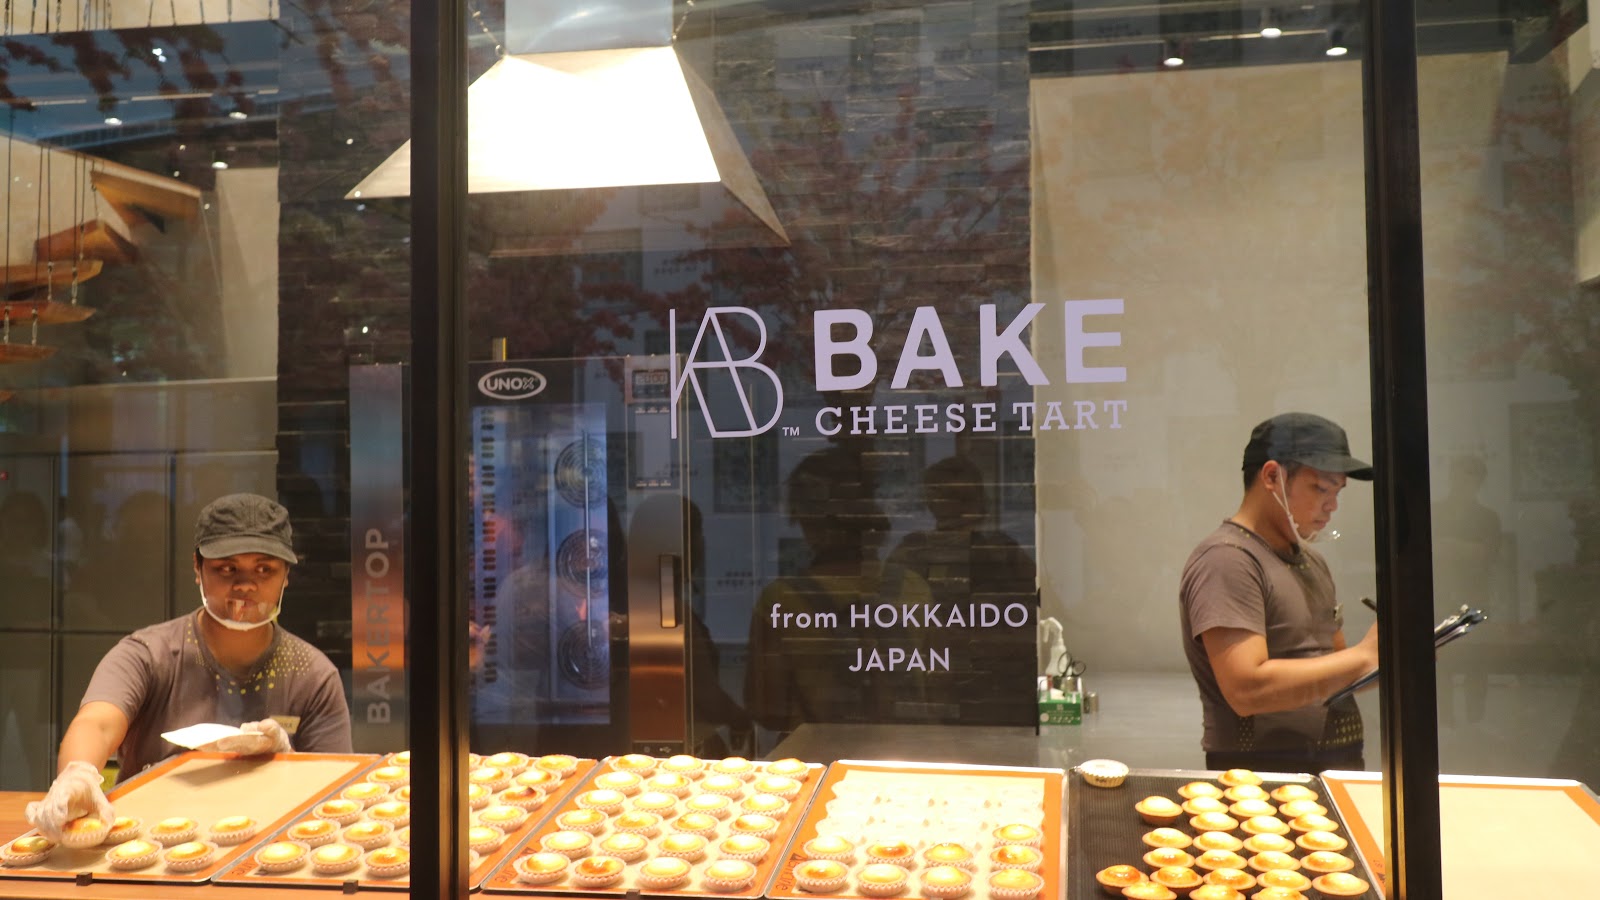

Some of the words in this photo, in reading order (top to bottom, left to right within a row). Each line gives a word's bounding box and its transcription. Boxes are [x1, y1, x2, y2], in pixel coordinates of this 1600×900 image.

[814, 298, 1127, 391] BAKE
[486, 377, 535, 391] UNOX
[815, 403, 998, 436] CHEESE
[1012, 399, 1128, 431] TART
[365, 528, 391, 724] BAKERTOP
[770, 603, 838, 629] from
[850, 602, 1029, 628] HOKKAIDO
[848, 647, 950, 672] JAPAN
